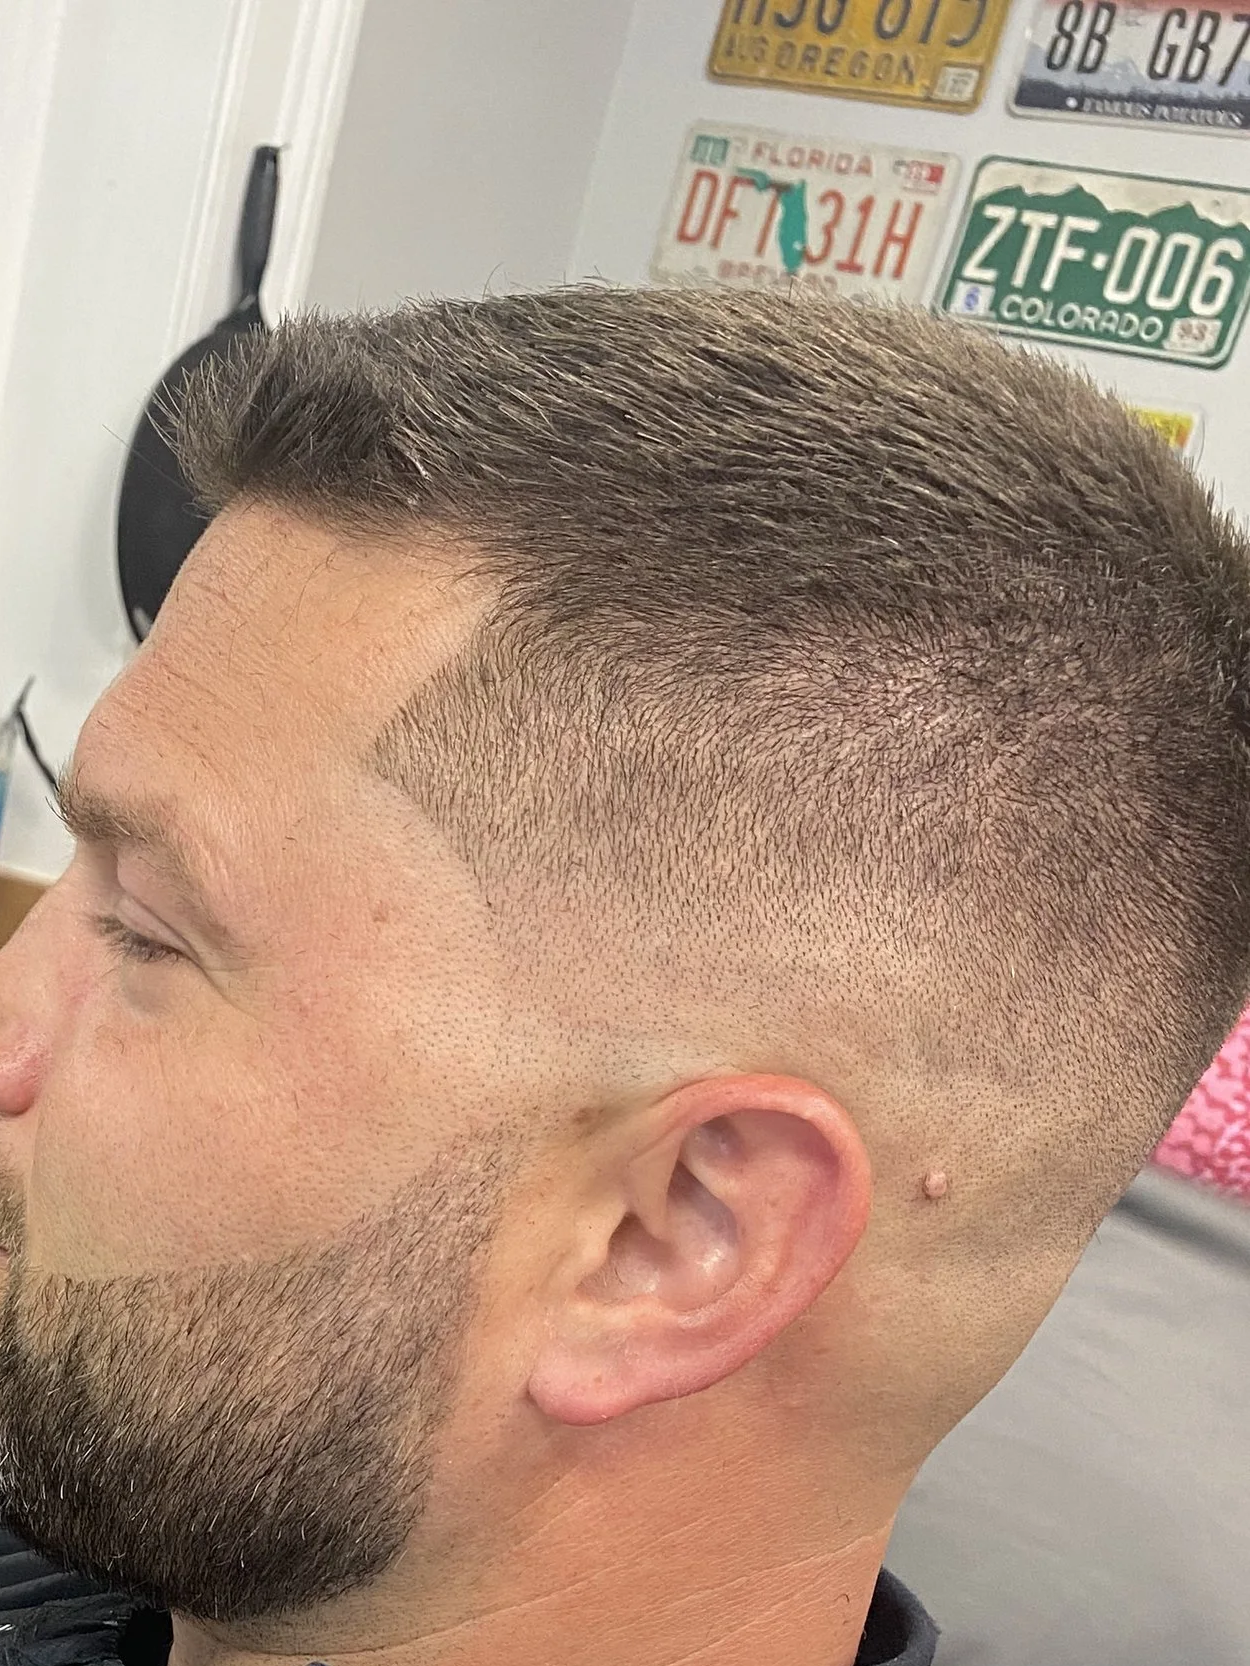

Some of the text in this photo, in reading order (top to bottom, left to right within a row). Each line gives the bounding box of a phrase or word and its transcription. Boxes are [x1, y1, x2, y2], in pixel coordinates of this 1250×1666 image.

[774, 40, 920, 87] OREGON
[1044, 0, 1250, 87] 8B GB7
[751, 140, 872, 177] FLORIDA
[803, 187, 924, 280] 31H
[1000, 294, 1163, 342] COLORADO
